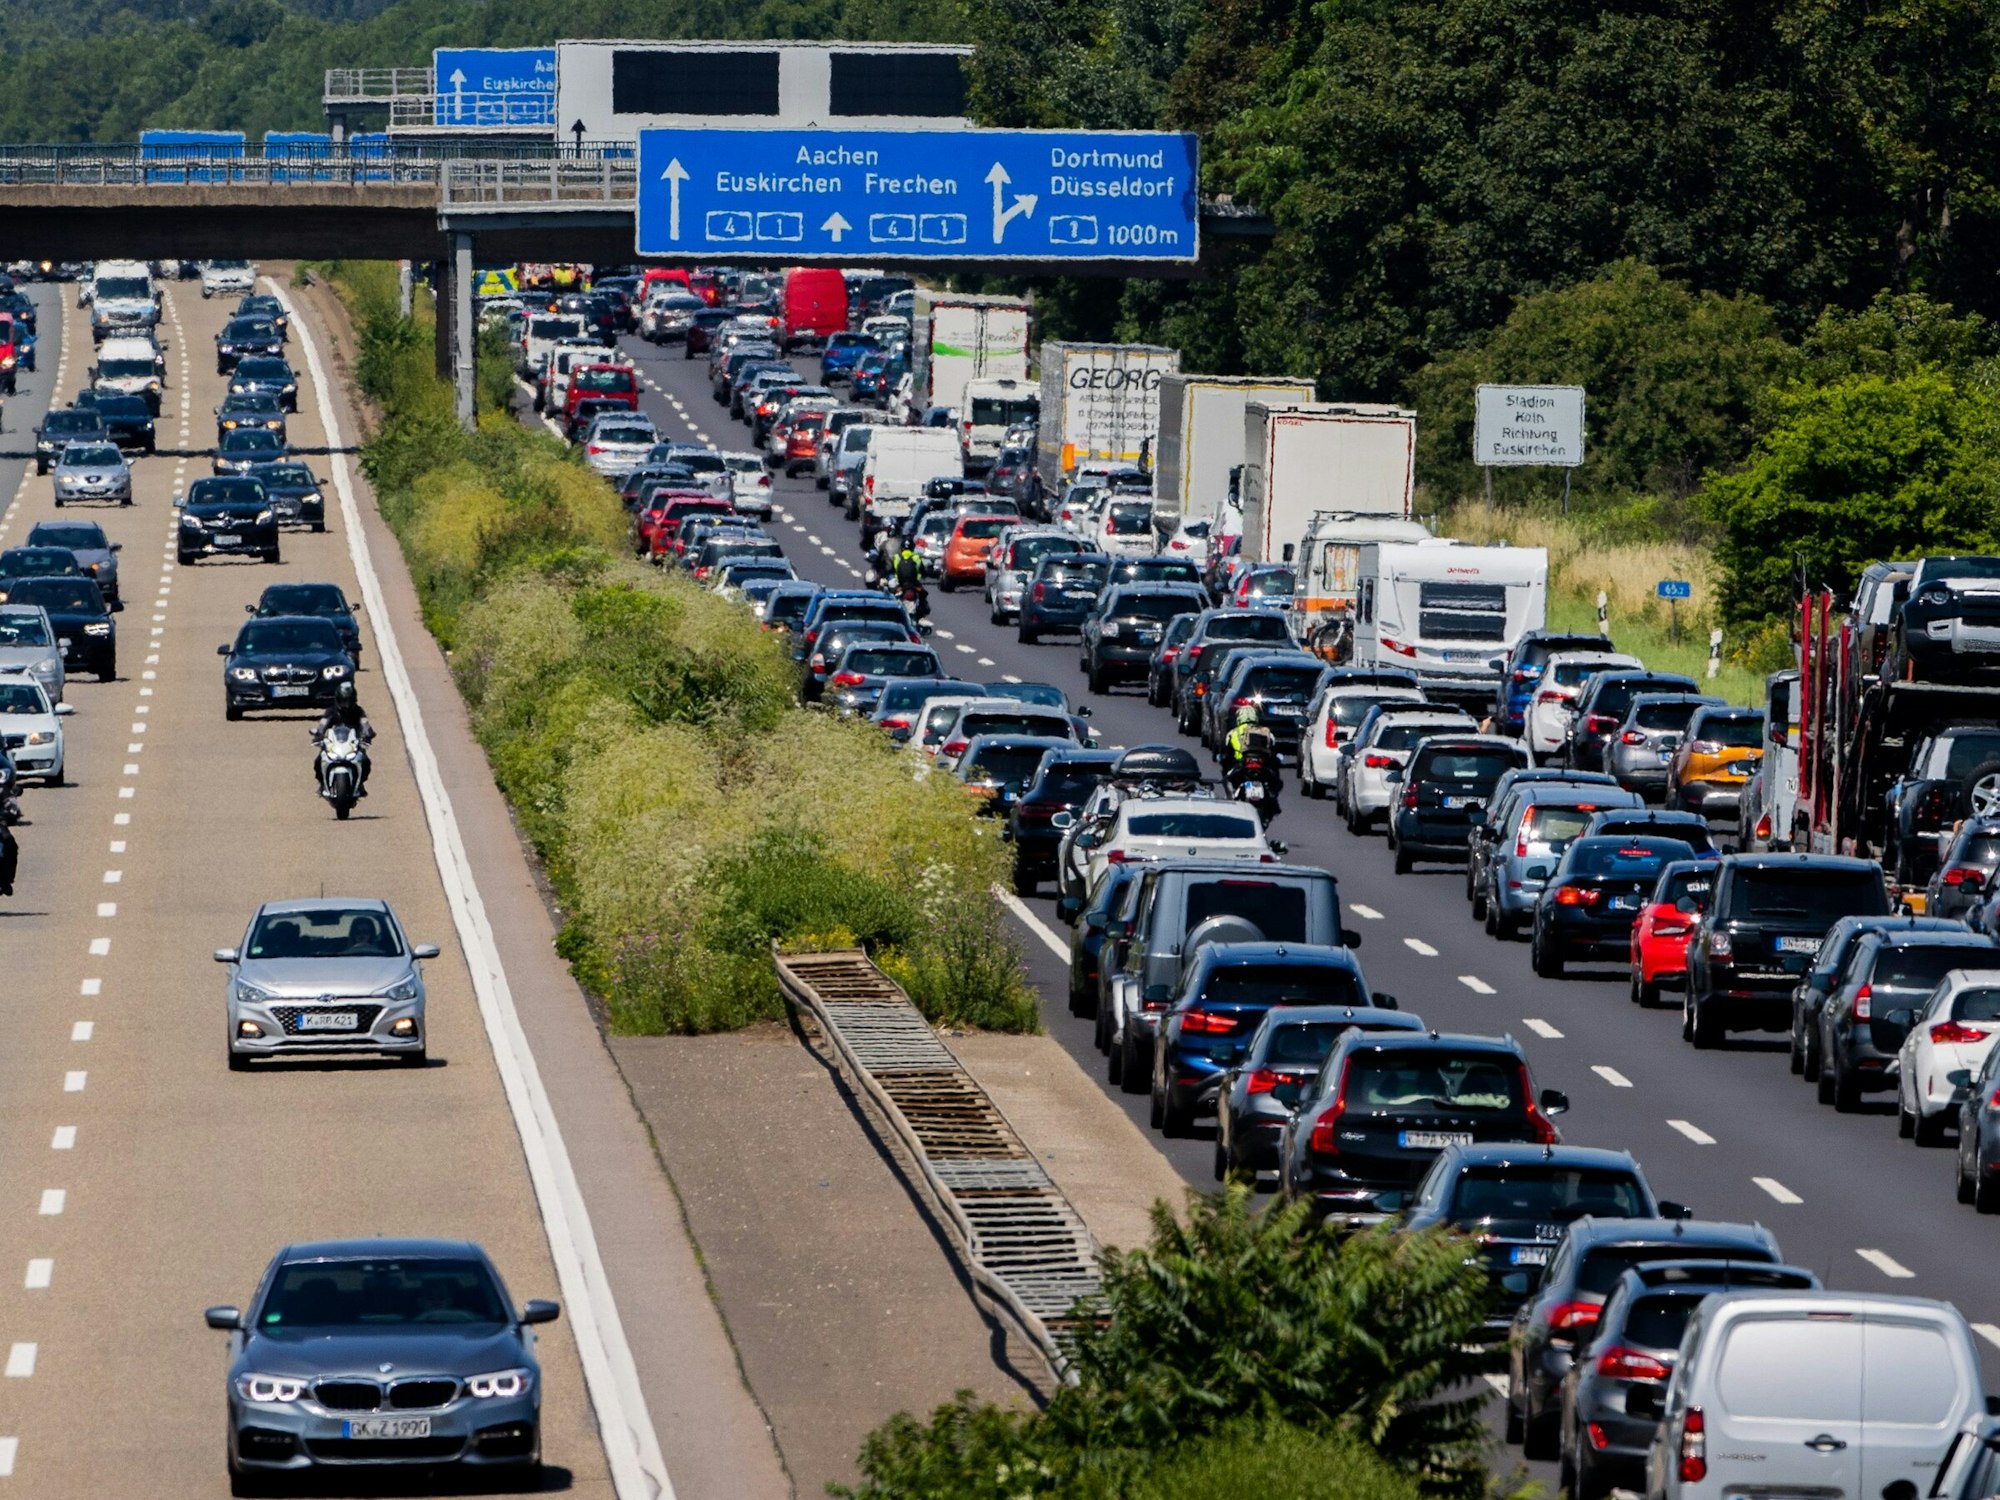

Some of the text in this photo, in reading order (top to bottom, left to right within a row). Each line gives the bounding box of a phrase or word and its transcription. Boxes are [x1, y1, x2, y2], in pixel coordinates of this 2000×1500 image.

[483, 77, 554, 90] Euskirche
[796, 145, 879, 165] Aachen
[1051, 147, 1164, 169] Dortmund
[716, 171, 958, 195] Euskirchen Frechen
[1050, 175, 1175, 198] Düsseldorf
[724, 217, 736, 235] 4
[776, 218, 783, 235] 1
[887, 220, 898, 237] 4
[941, 220, 948, 237] 1
[1069, 220, 1077, 238] 1
[1069, 367, 1161, 391] GEORG
[1505, 394, 1555, 409] Stadion
[1502, 427, 1558, 443] Richtung
[1493, 442, 1566, 456] Euskirchen
[334, 1016, 353, 1026] 421
[392, 1420, 428, 1436] 1990
